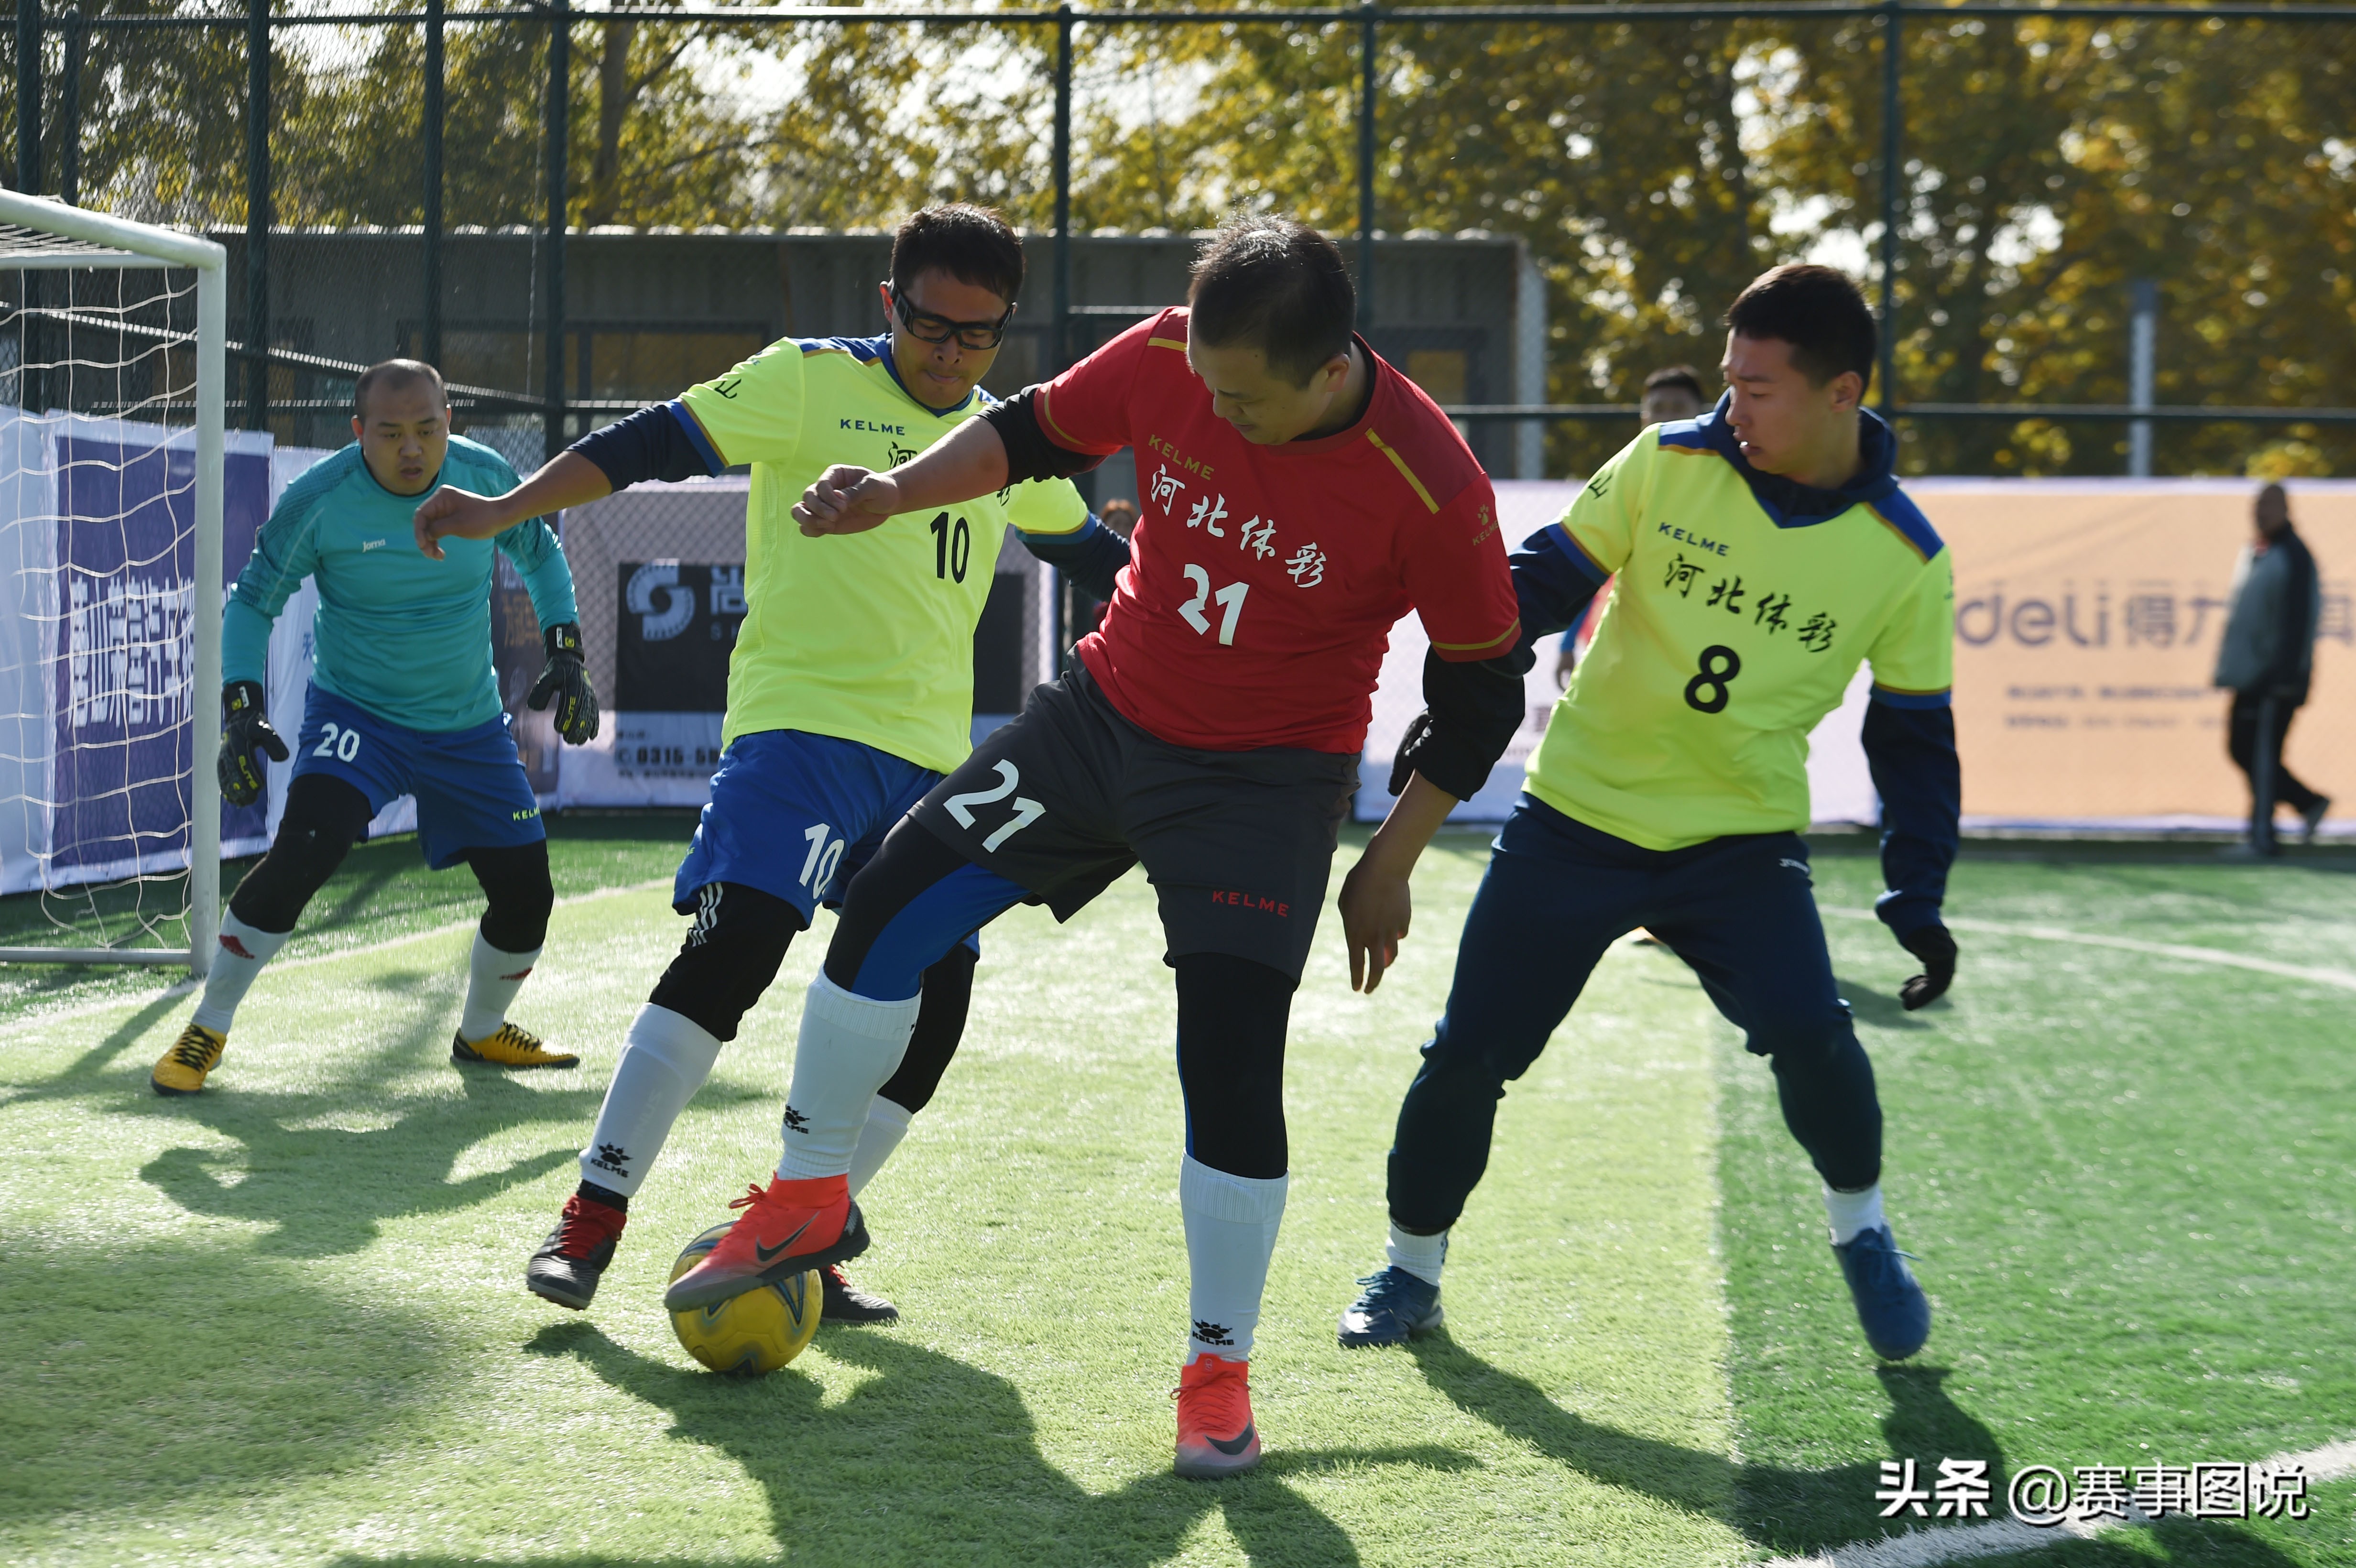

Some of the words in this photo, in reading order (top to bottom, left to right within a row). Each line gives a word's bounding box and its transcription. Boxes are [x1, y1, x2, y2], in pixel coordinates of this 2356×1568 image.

[840, 419, 905, 436] KELME
[1148, 434, 1214, 480] KELME
[930, 512, 970, 584] 10
[1150, 464, 1327, 588] 河北体彩
[1472, 520, 1498, 546] KELME
[1658, 522, 1730, 556] KELME
[1178, 564, 1250, 646] 21
[1664, 553, 1837, 653] 河北体彩
[1956, 594, 2110, 648] deli
[1684, 645, 1741, 714] 8
[312, 722, 360, 762] 20
[513, 805, 540, 821] KELM
[943, 759, 1047, 853] 21
[799, 823, 845, 899] 10
[1212, 890, 1289, 917] KELME
[590, 1158, 629, 1178] KELME
[1192, 1330, 1234, 1346] KELME
